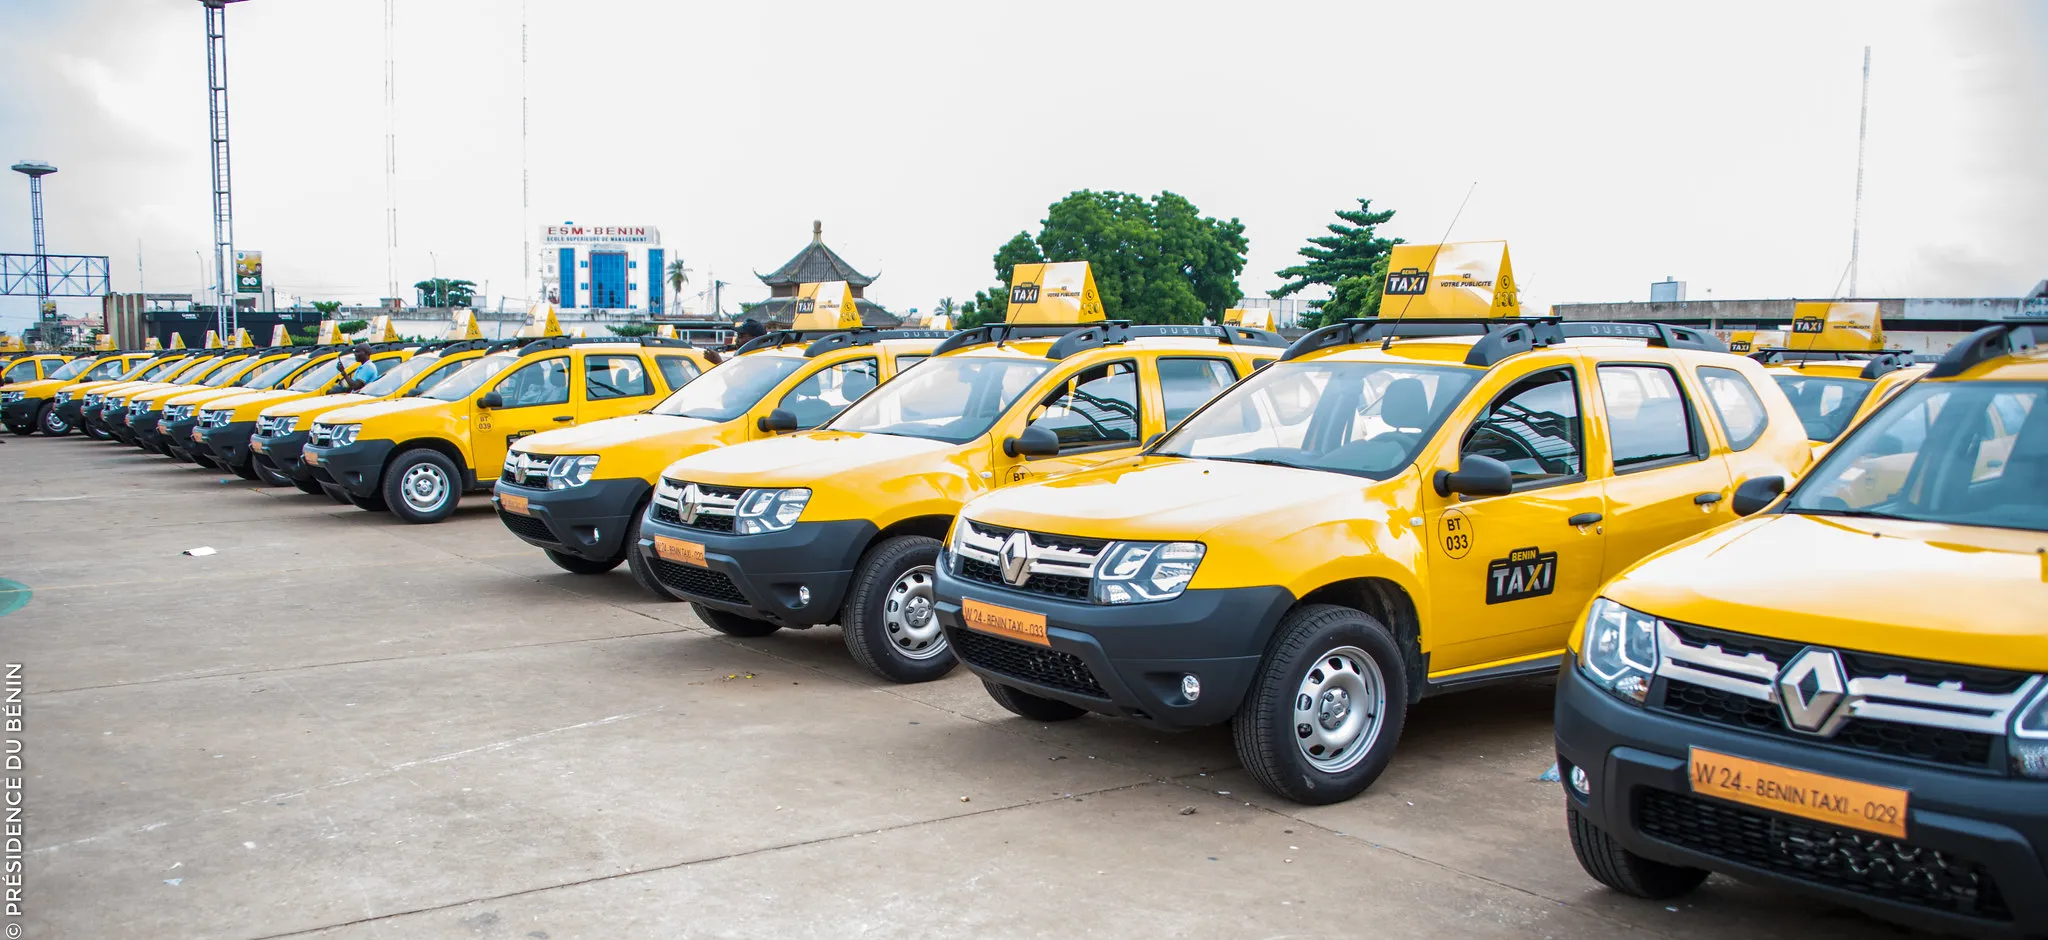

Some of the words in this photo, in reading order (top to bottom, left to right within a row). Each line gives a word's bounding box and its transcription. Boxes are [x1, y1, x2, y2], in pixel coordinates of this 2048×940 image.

[548, 227, 645, 235] ESM-BENIN
[1390, 277, 1426, 292] TAXI
[1014, 289, 1037, 301] TAXI
[1496, 292, 1515, 307] 130
[798, 302, 814, 312] TAXI
[1082, 302, 1100, 315] 130
[1160, 327, 1222, 335] DUSTER
[1590, 325, 1657, 336] DUSTER
[1796, 321, 1823, 332] TAXI
[1731, 343, 1750, 352] TAXI
[1013, 472, 1025, 482] BT
[1447, 517, 1461, 531] BT
[1446, 534, 1469, 551] 033
[1511, 549, 1537, 562] BENIN
[1492, 562, 1552, 597] TAXI
[964, 606, 973, 622] W
[973, 608, 982, 622] 24
[987, 613, 1007, 629] BENIN
[1008, 618, 1024, 632] TAXI
[1029, 623, 1044, 638] 033
[1695, 761, 1716, 784] W
[1720, 767, 1742, 791] 24
[1755, 777, 1807, 805] BENIN
[1810, 789, 1848, 814] TAXI
[1863, 801, 1898, 824] 029
